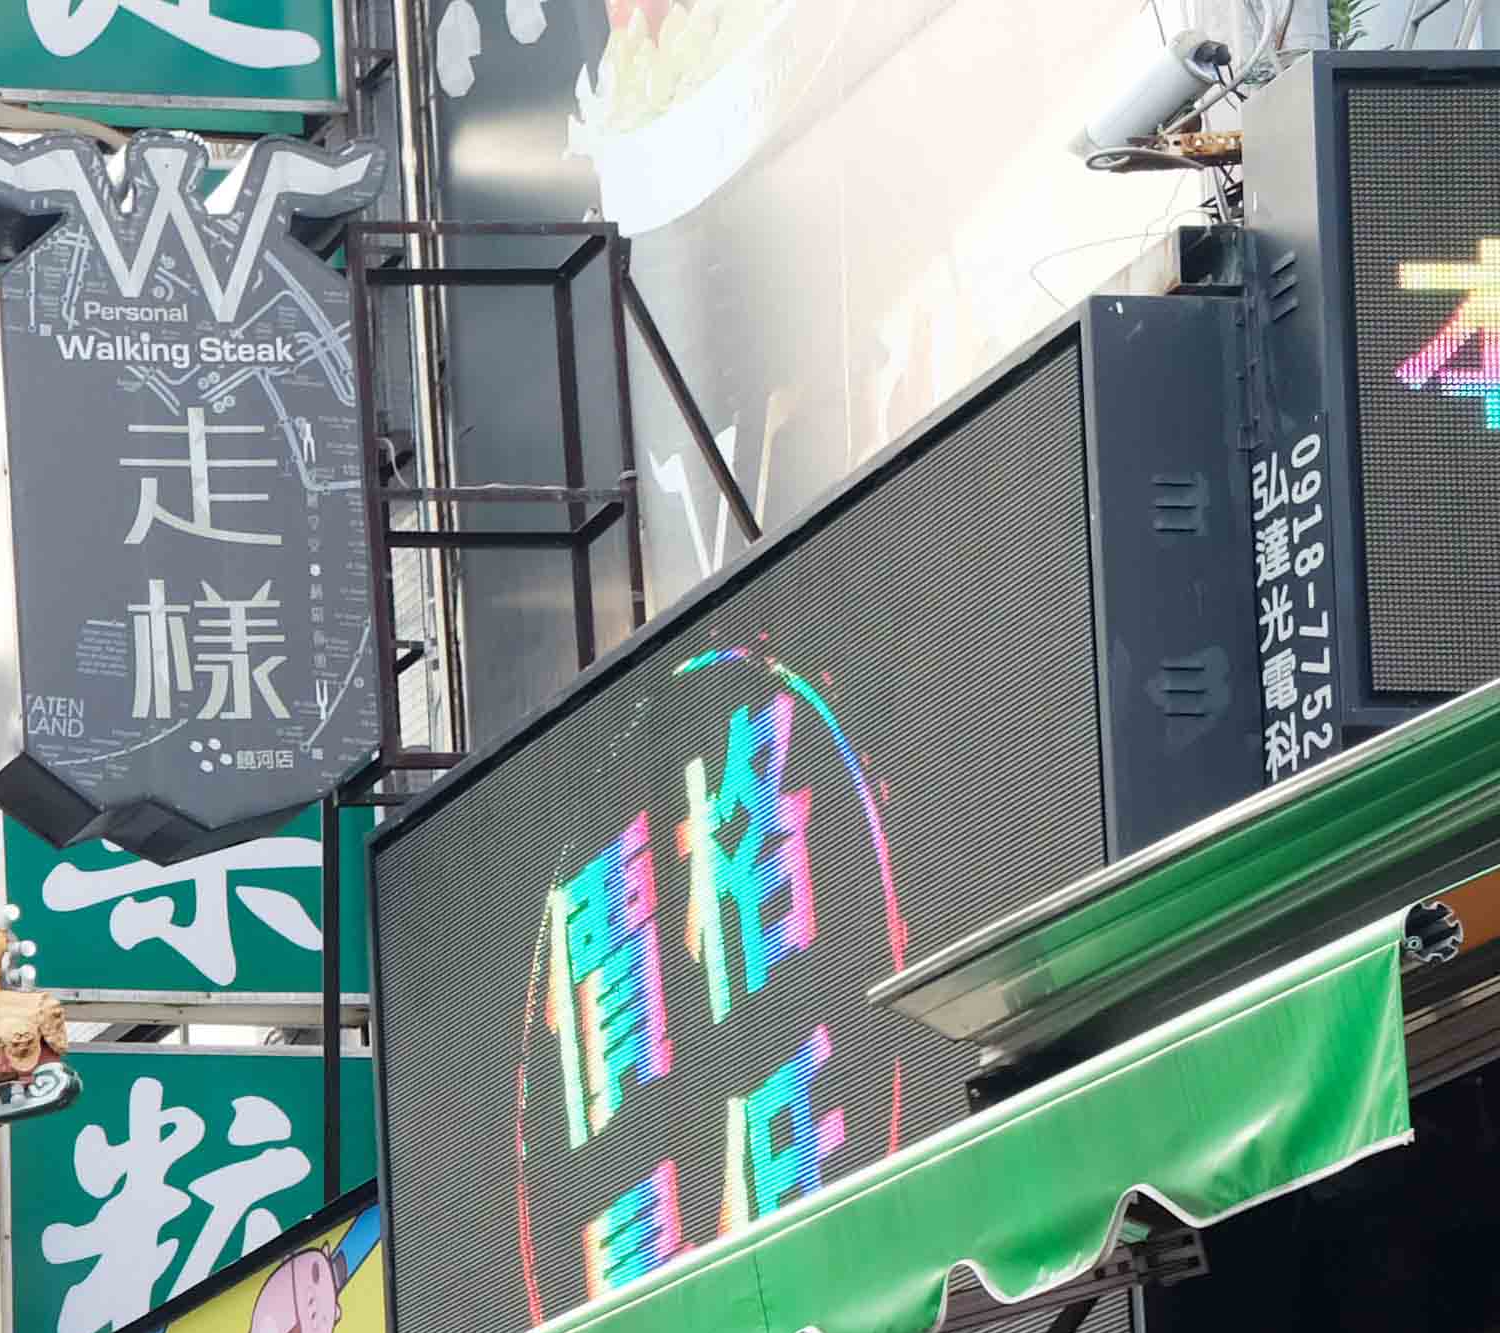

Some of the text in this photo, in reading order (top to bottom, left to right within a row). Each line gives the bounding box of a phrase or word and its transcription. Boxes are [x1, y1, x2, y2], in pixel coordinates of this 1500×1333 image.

[84, 302, 188, 322] Personal
[56, 332, 296, 368] Walking Steak
[119, 406, 290, 721] 走樣
